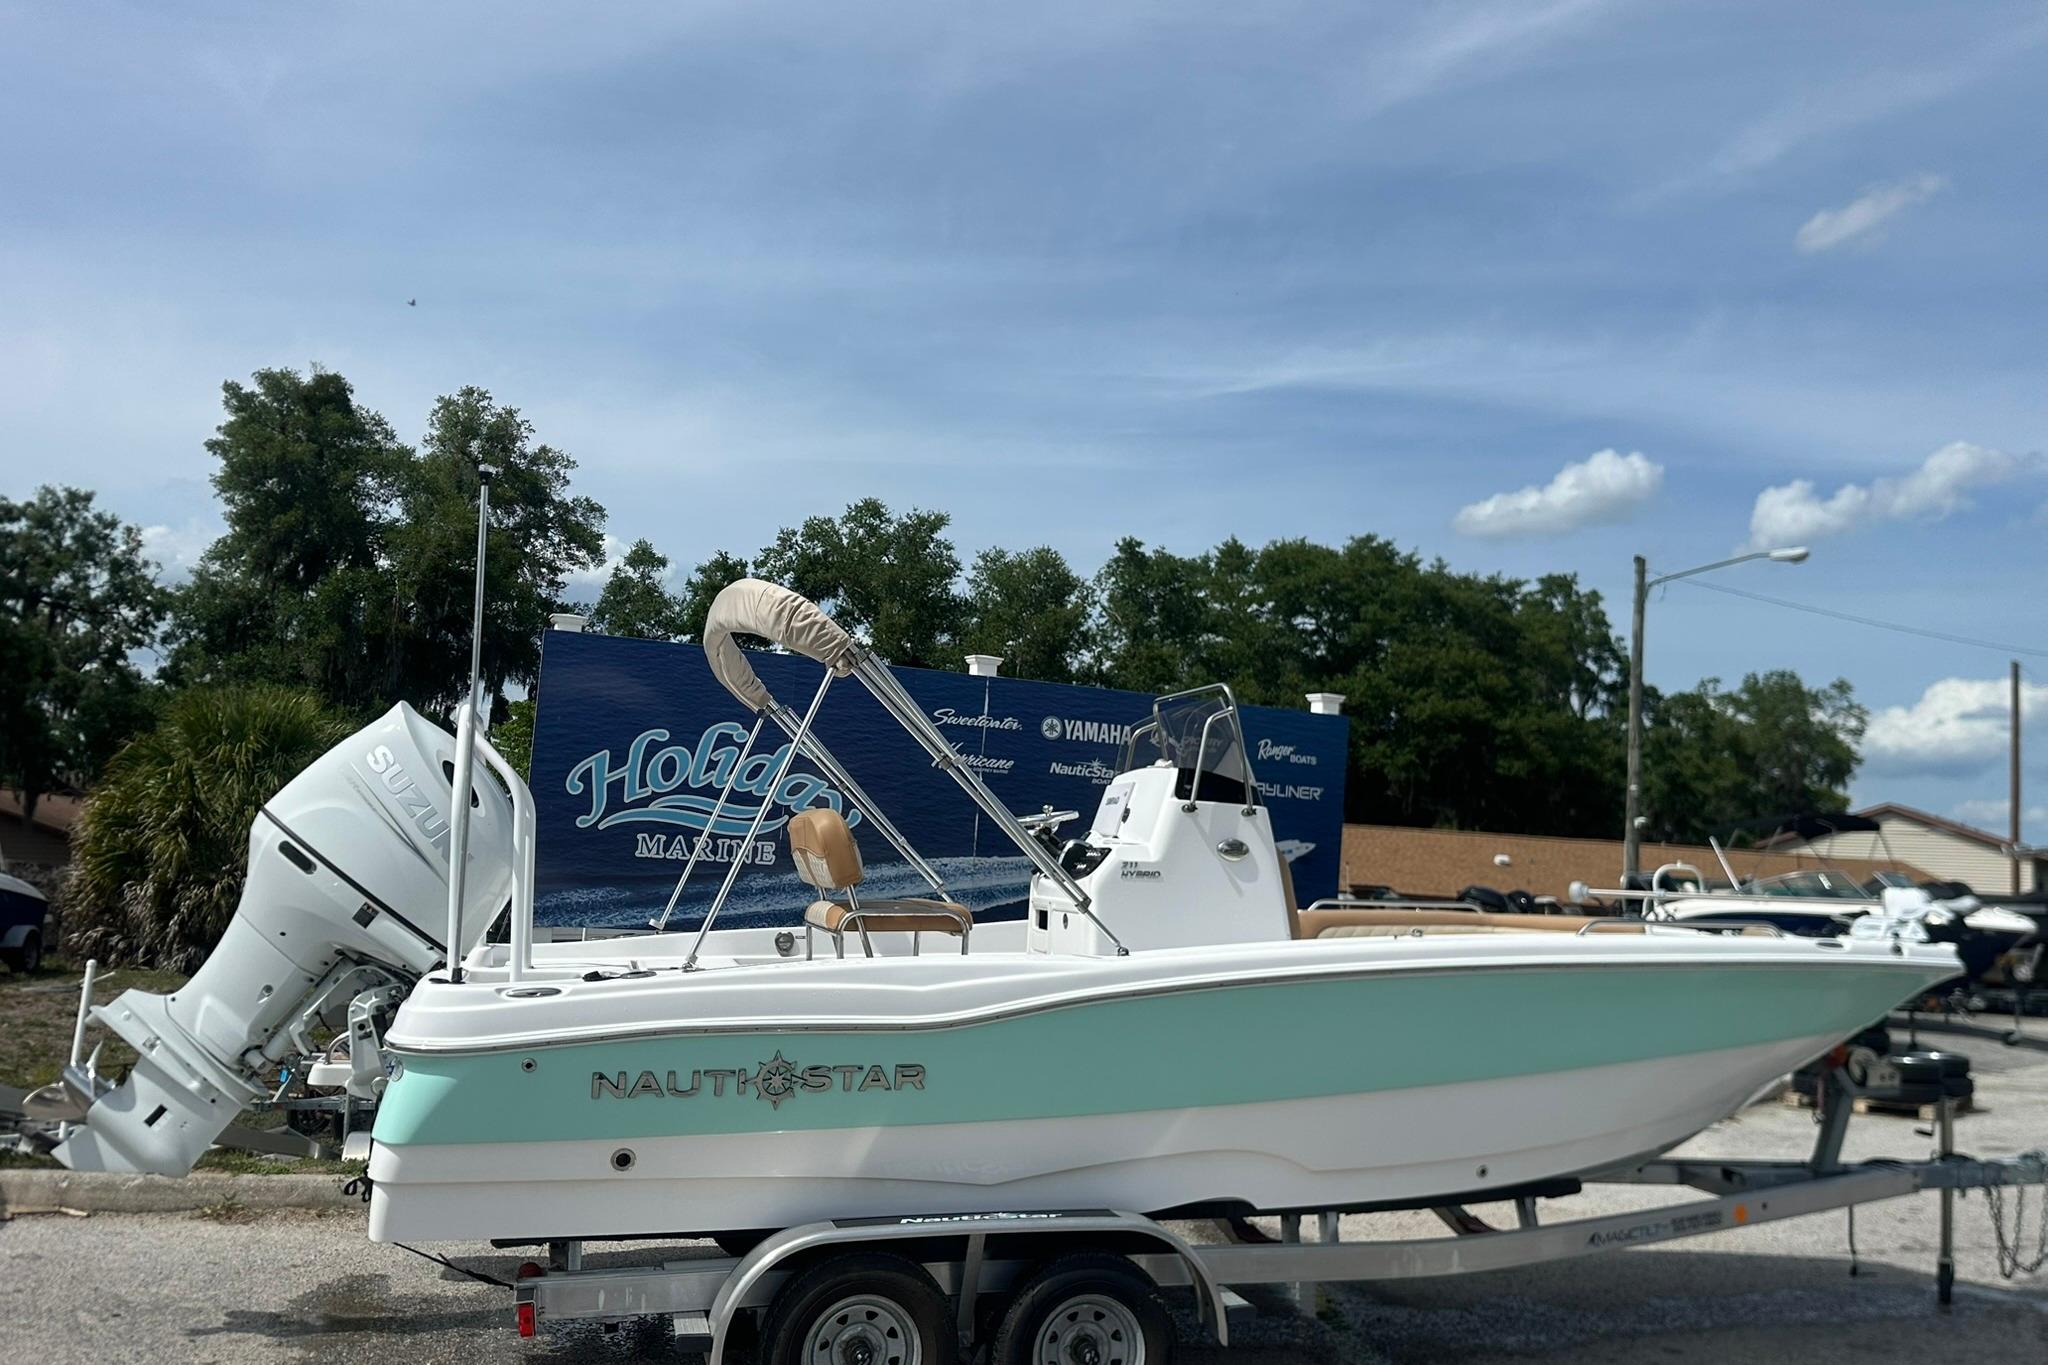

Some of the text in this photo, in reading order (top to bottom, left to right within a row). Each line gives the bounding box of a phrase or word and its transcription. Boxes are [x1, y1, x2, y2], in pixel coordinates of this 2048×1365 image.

[1064, 719, 1131, 745] YAMAHA
[1258, 738, 1294, 760] Ranger
[1290, 754, 1317, 766] BOATS
[1255, 782, 1321, 801] AYLINER
[366, 745, 475, 864] SUZU
[635, 833, 776, 865] MARINE
